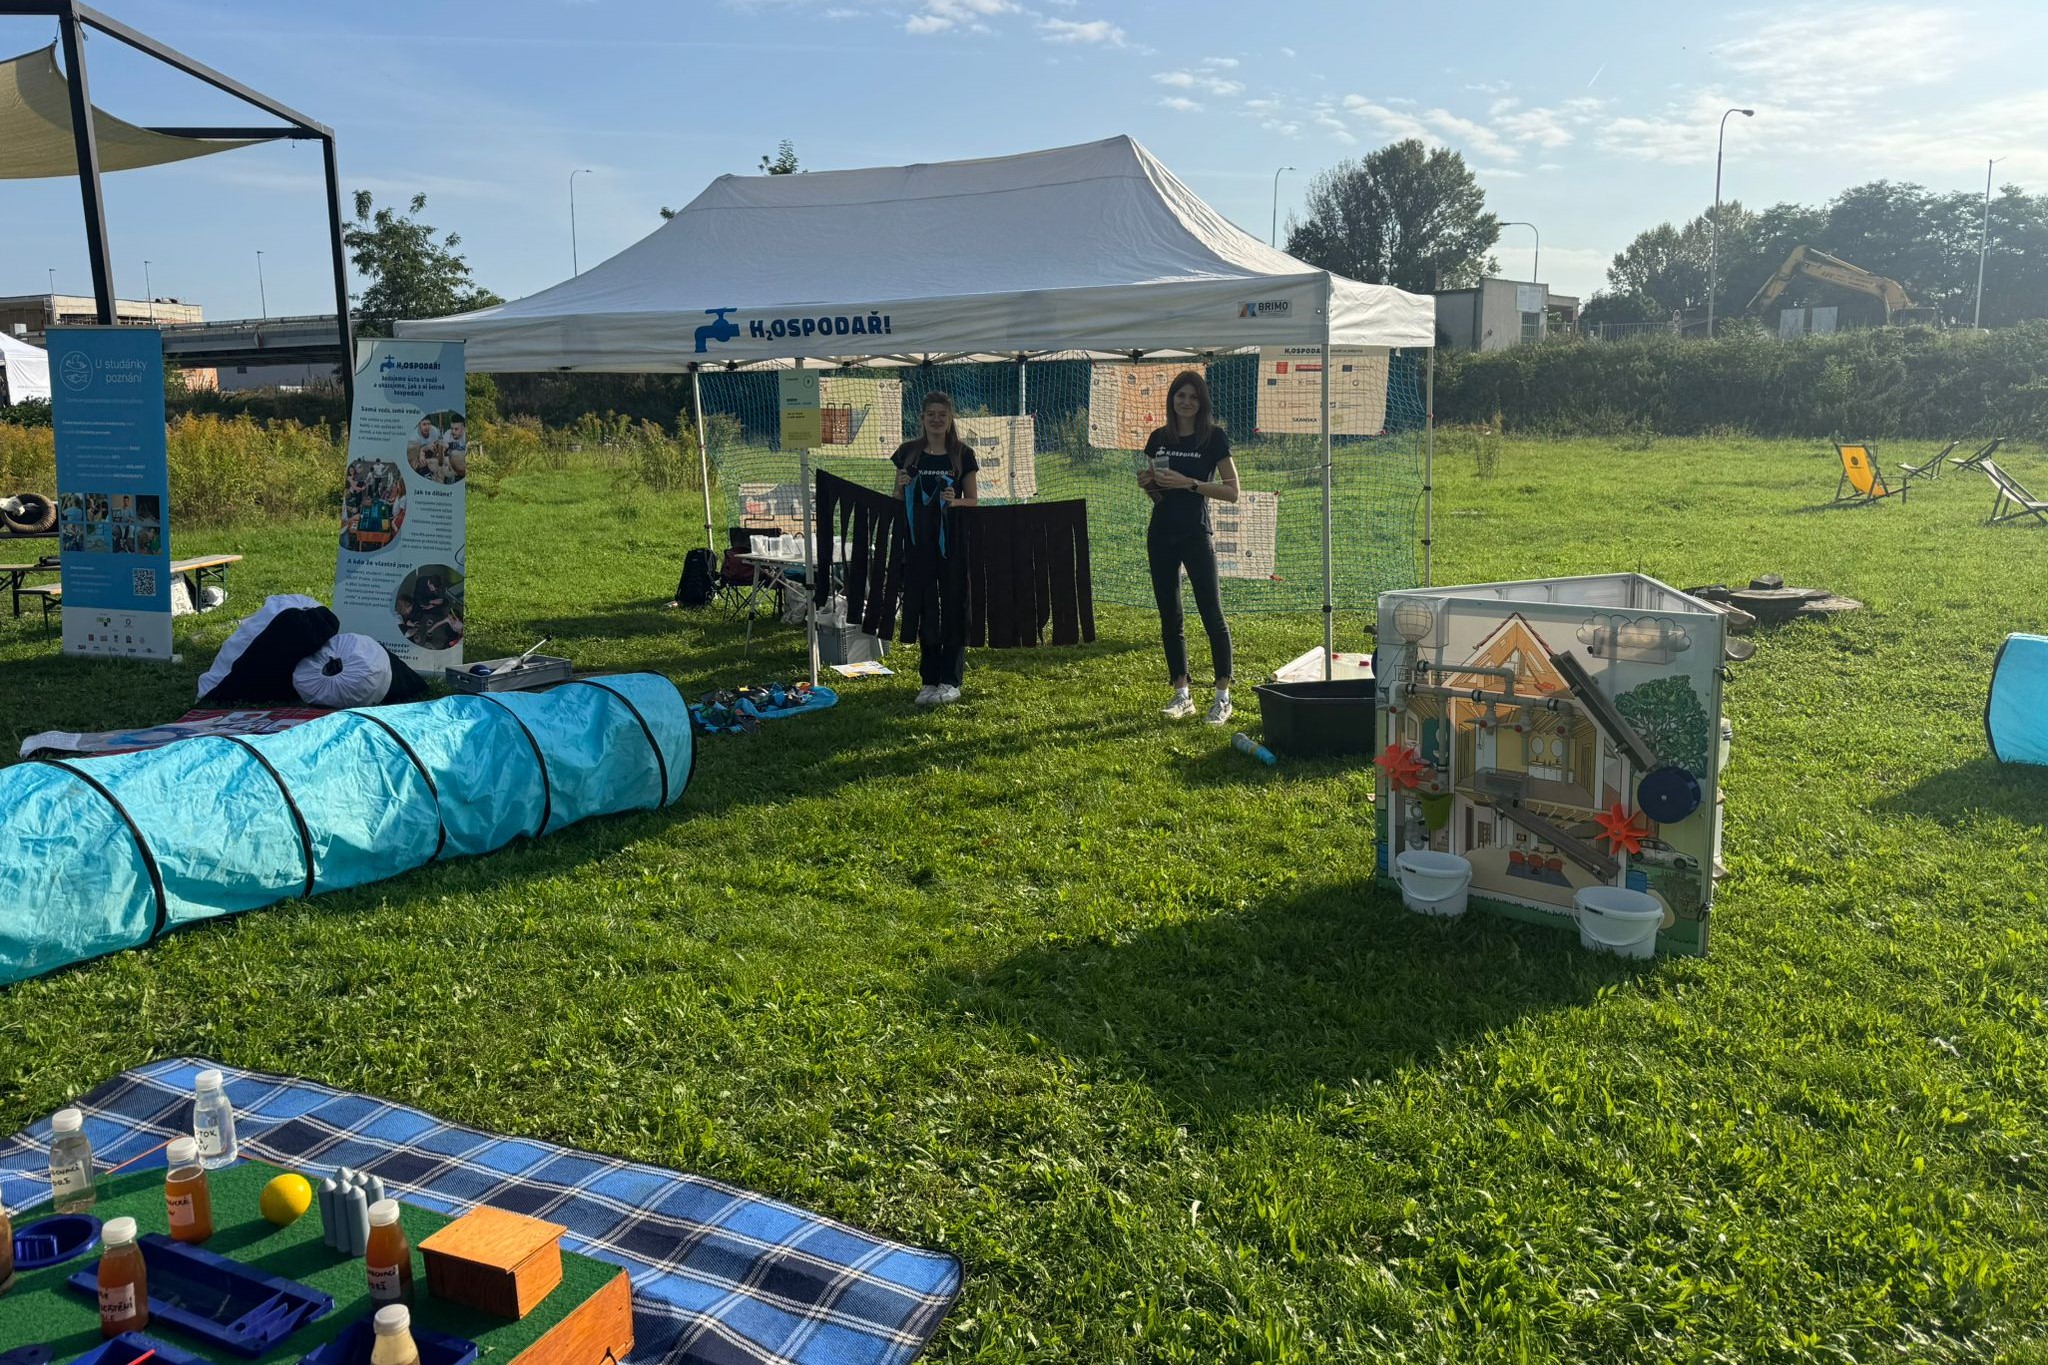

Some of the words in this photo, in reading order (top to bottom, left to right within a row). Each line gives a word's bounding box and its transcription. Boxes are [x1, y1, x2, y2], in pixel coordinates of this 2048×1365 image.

[1258, 301, 1289, 311] BRIMO
[750, 310, 892, 341] H2OSPODAŘ!
[1284, 347, 1321, 355] H2OSPODA
[95, 359, 103, 369] U
[105, 358, 147, 372] studánky
[105, 372, 143, 385] poznání
